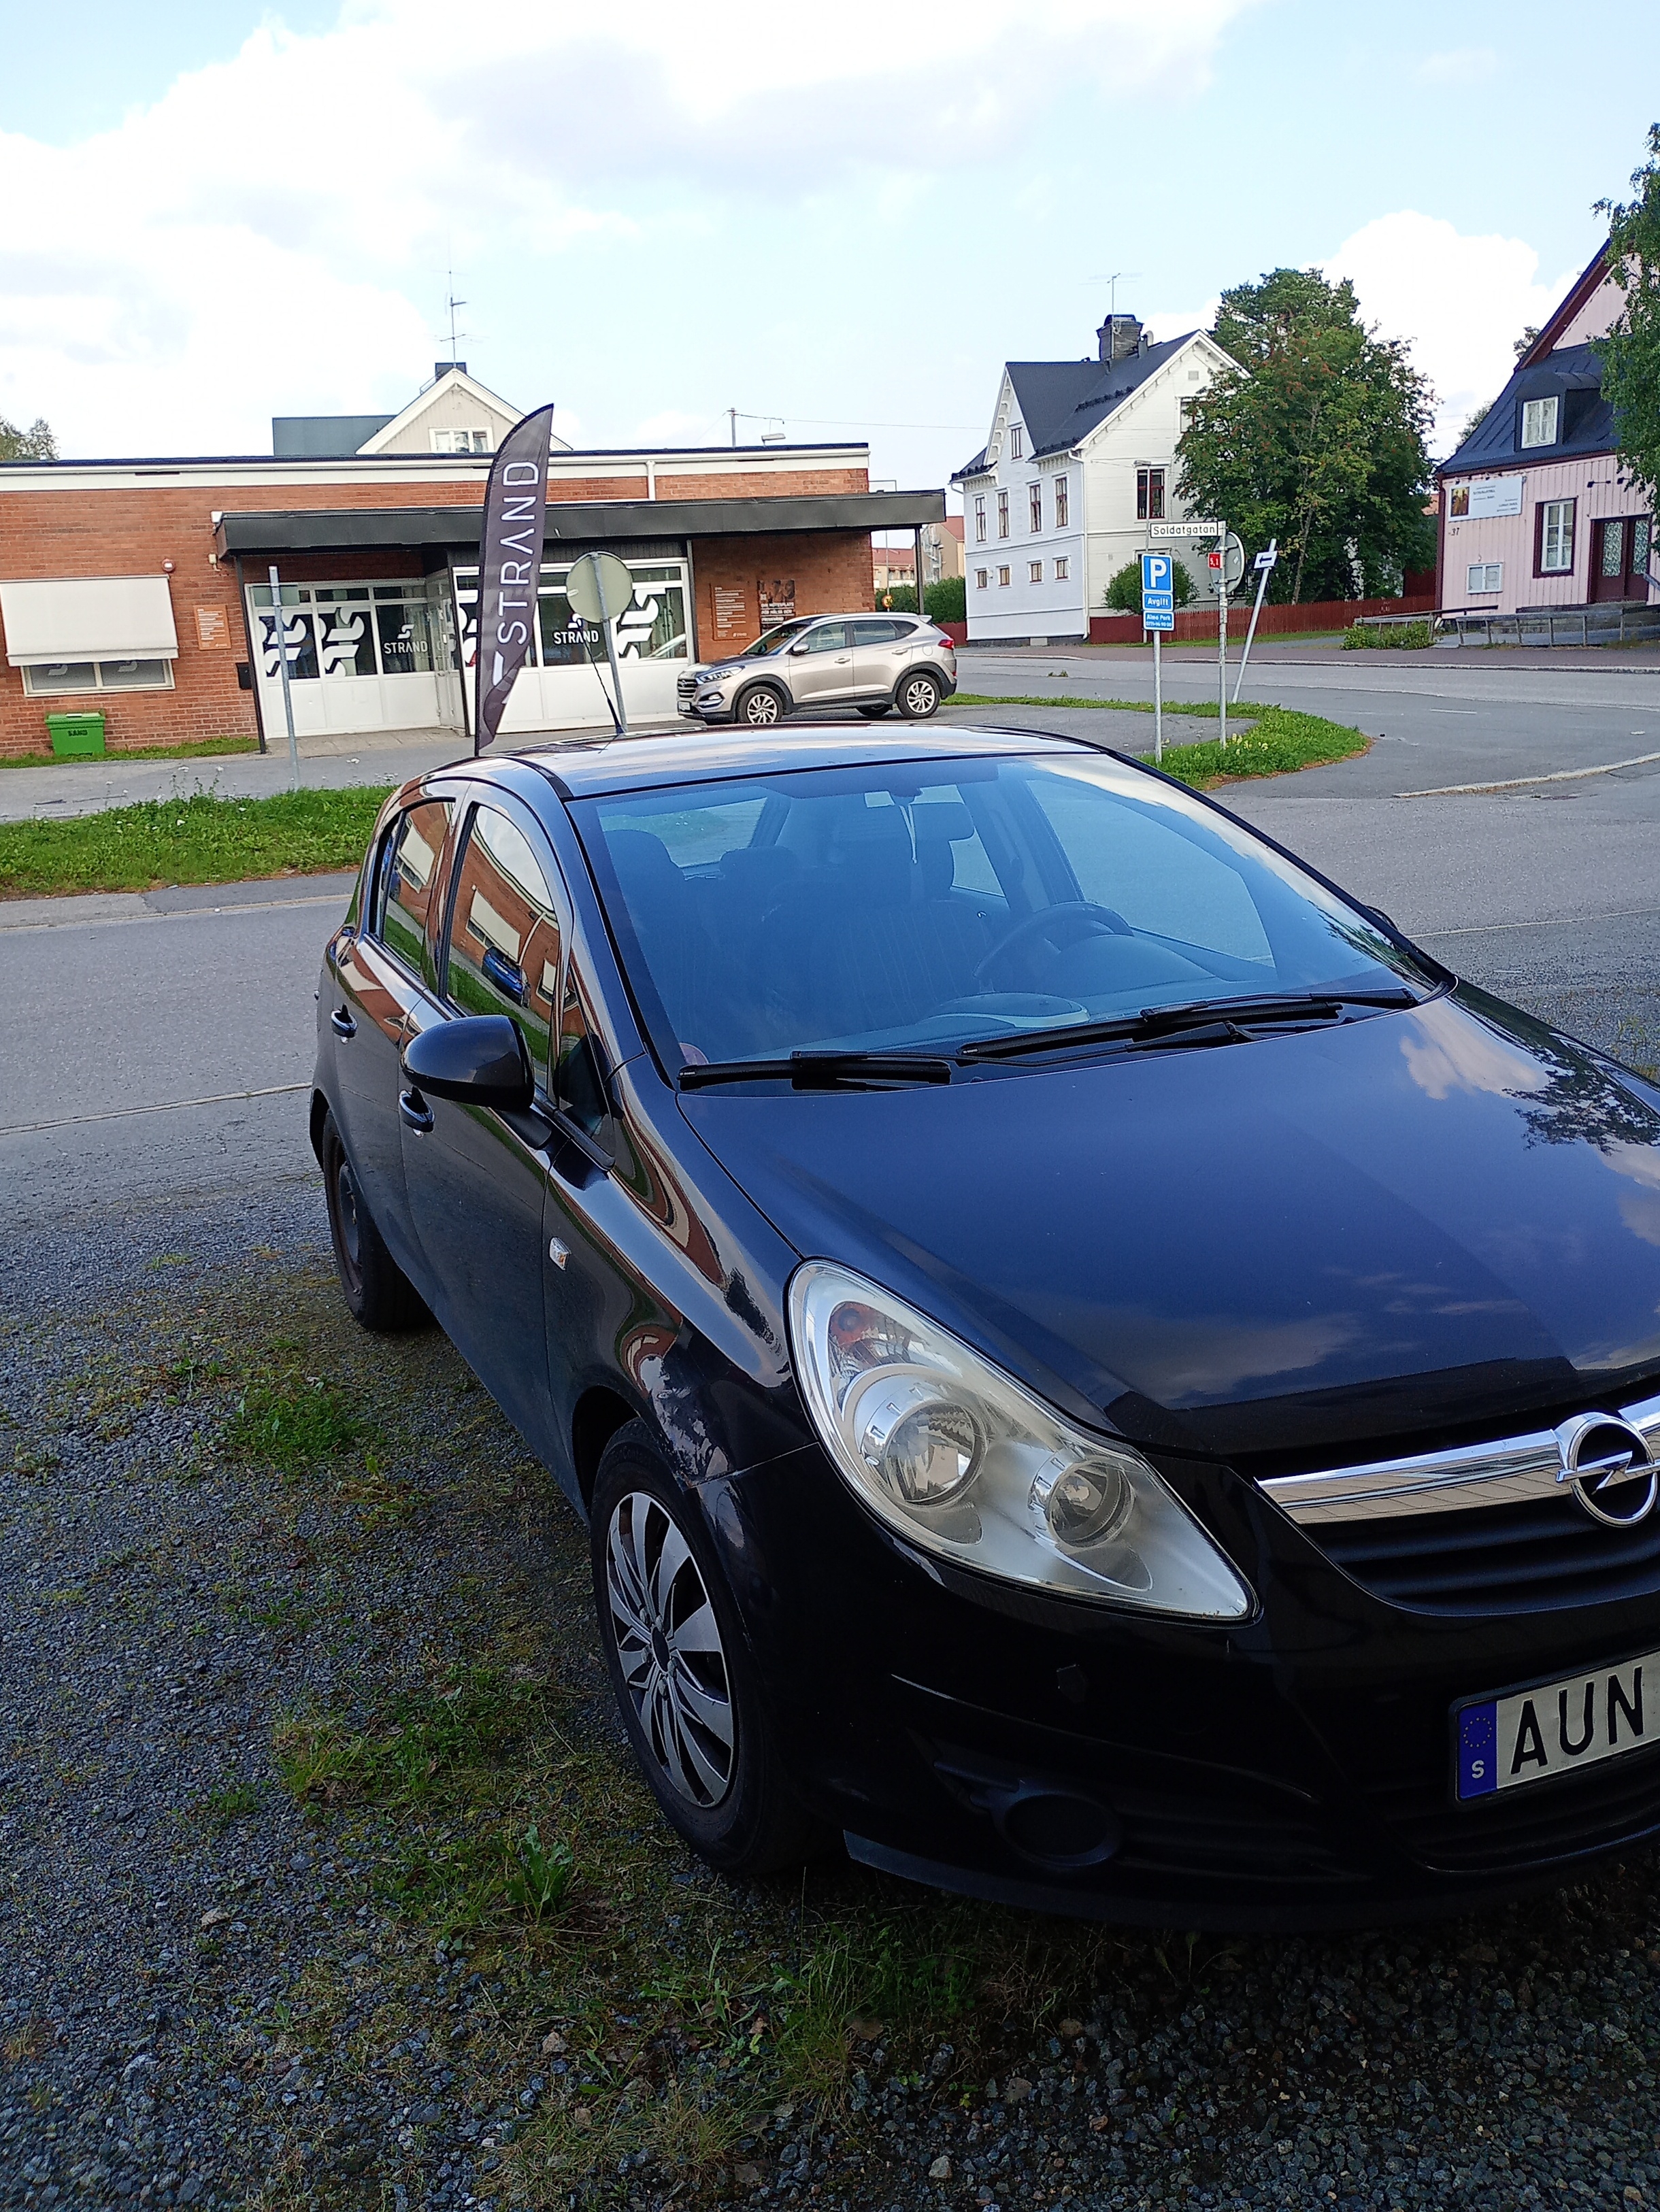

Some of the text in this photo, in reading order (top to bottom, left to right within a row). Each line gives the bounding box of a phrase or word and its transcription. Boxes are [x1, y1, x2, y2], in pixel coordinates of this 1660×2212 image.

[1153, 525, 1215, 535] Soldatgatan
[497, 461, 540, 645] STRAND
[1150, 558, 1167, 588] P
[1148, 597, 1169, 607] Avgift
[552, 631, 599, 645] STRAND
[384, 641, 429, 654] STRAND
[1510, 1665, 1644, 1775] AUN
[1472, 1760, 1484, 1779] S
